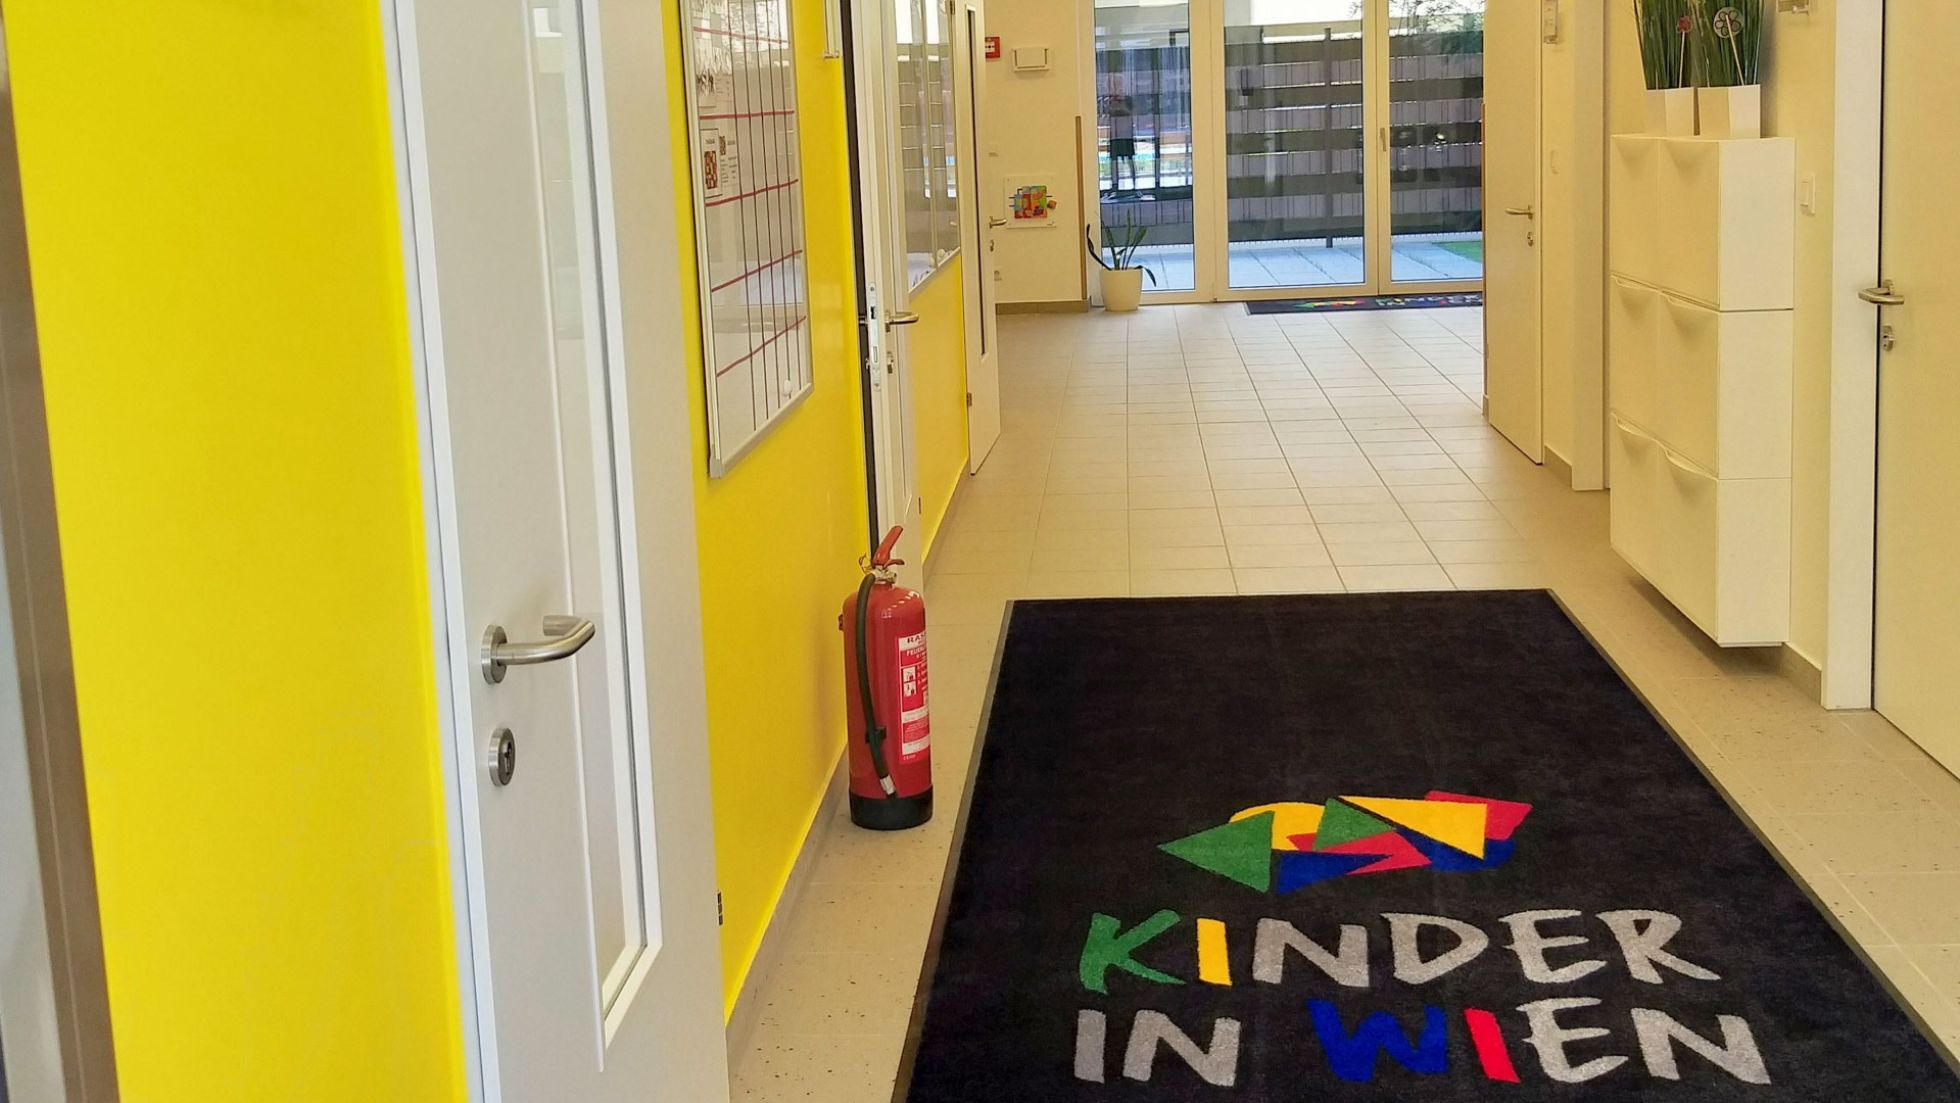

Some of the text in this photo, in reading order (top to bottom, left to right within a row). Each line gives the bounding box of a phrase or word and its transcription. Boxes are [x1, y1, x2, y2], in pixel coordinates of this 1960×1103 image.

[1080, 909, 1721, 994] KINDER
[1074, 998, 1770, 1087] IN WIEN
